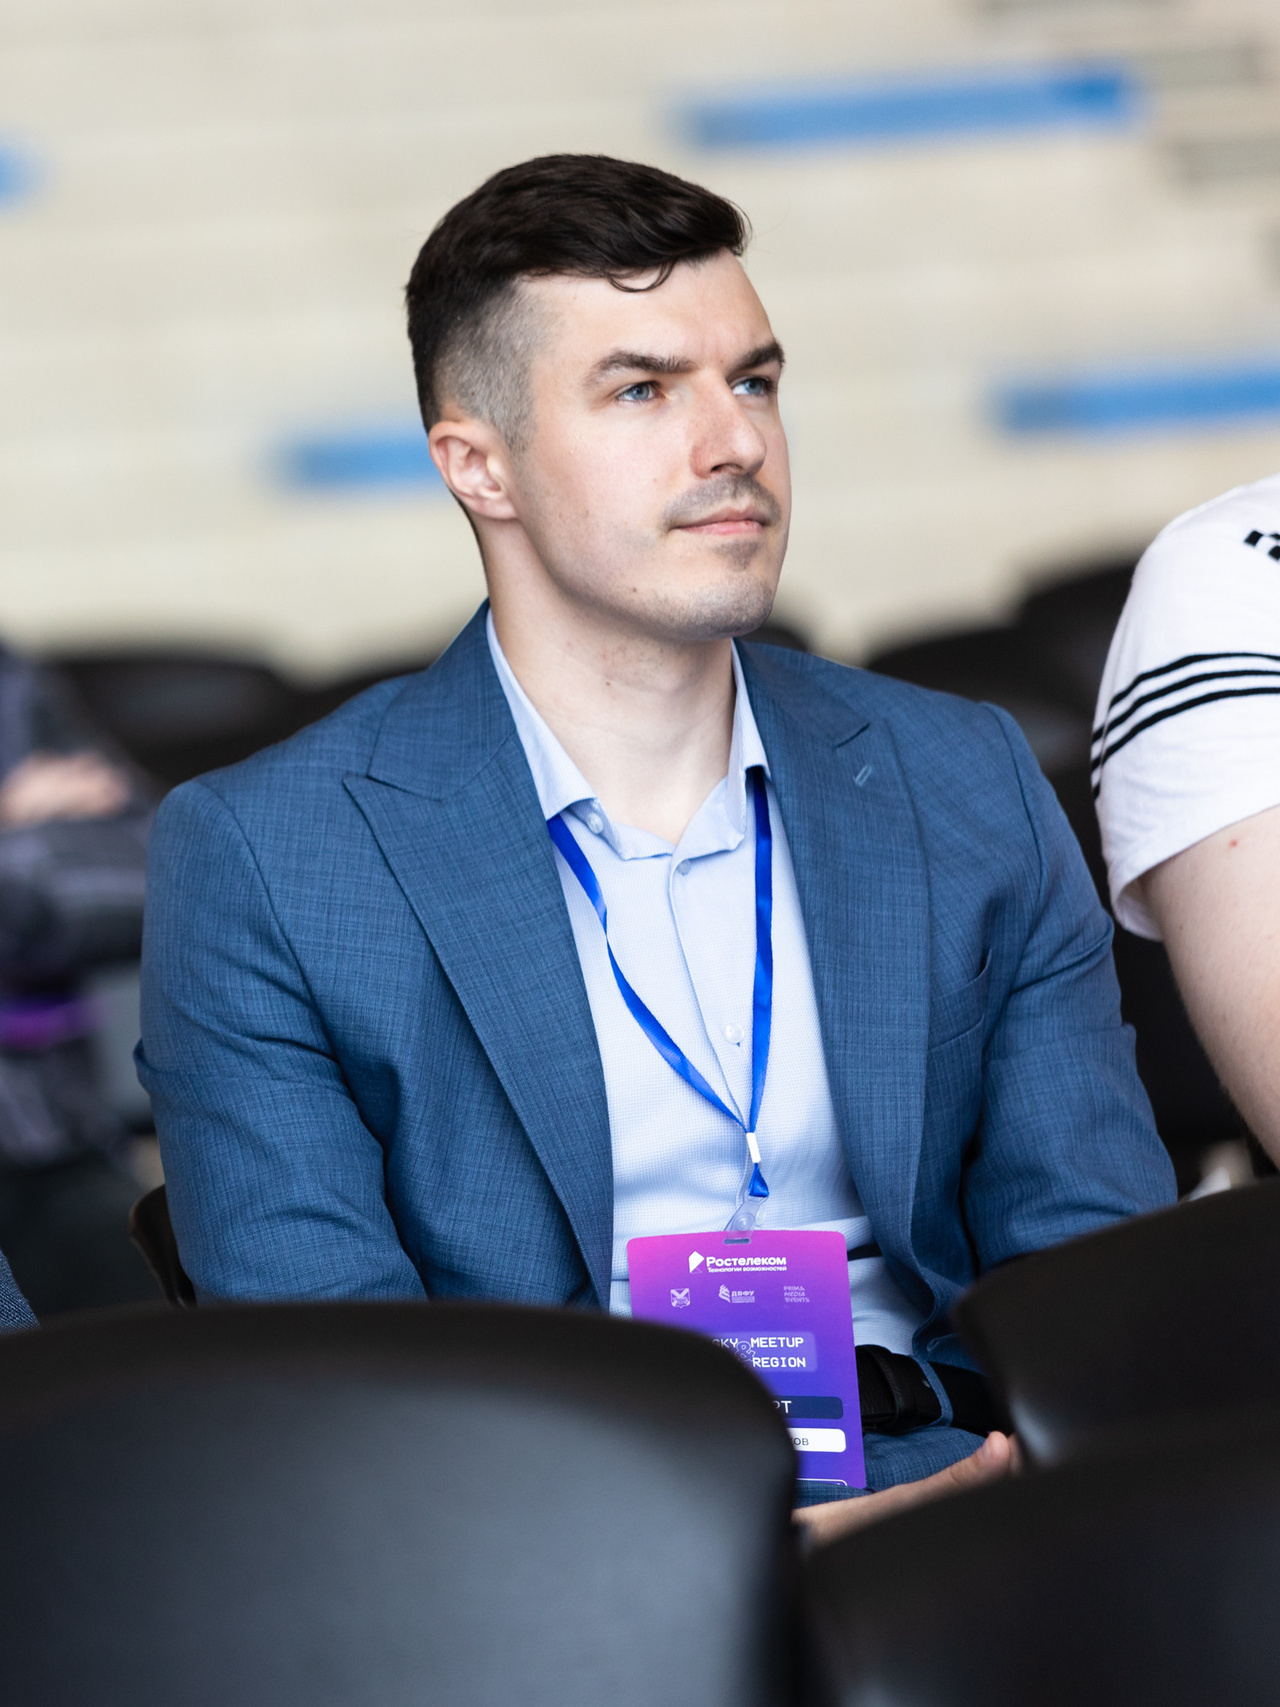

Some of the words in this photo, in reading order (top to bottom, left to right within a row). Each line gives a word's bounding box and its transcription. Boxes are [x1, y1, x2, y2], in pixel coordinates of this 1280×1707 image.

[706, 1256, 787, 1267] Ростелеком
[750, 1337, 804, 1348] MEETUP
[752, 1356, 807, 1368] REGION
